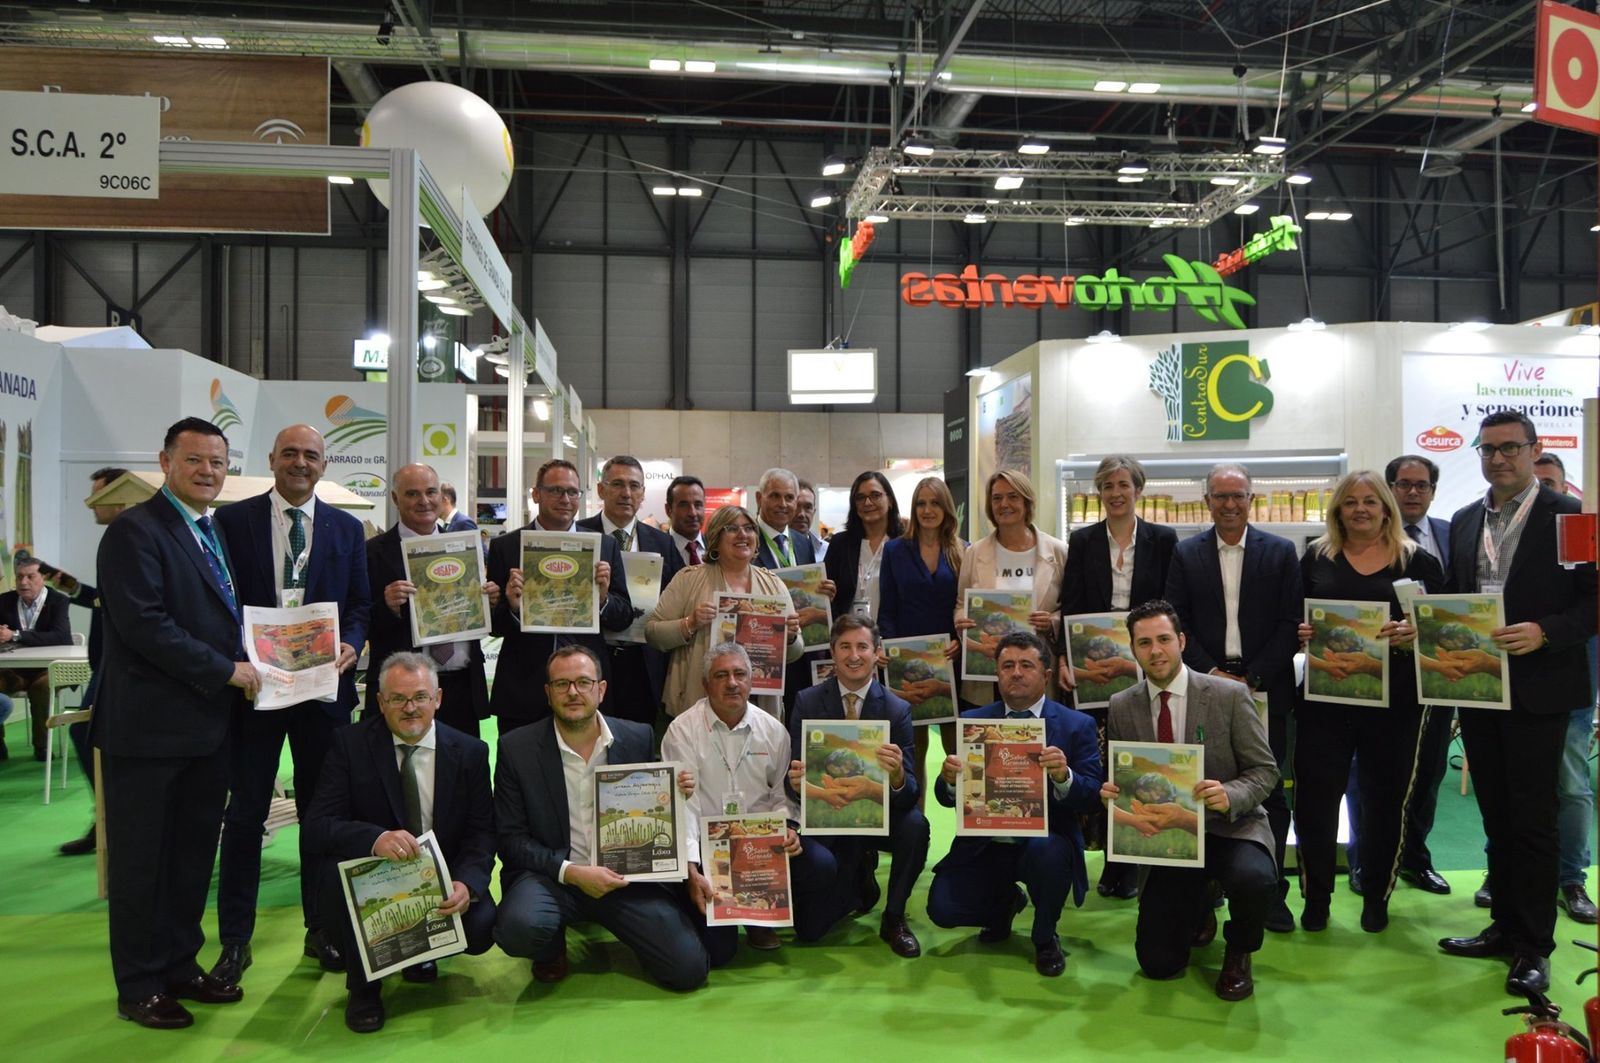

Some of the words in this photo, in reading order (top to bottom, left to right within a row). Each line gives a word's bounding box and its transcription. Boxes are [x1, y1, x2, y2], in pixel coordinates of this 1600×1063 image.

[11, 128, 86, 158] S.C.A.
[100, 132, 127, 159] 2º
[100, 175, 151, 190] 9C06C
[1504, 360, 1545, 381] Vive
[1477, 383, 1496, 397] las
[1499, 384, 1573, 397] emociones
[1461, 403, 1472, 420] y
[1417, 434, 1461, 446] Cesurca
[373, 455, 388, 464] GR
